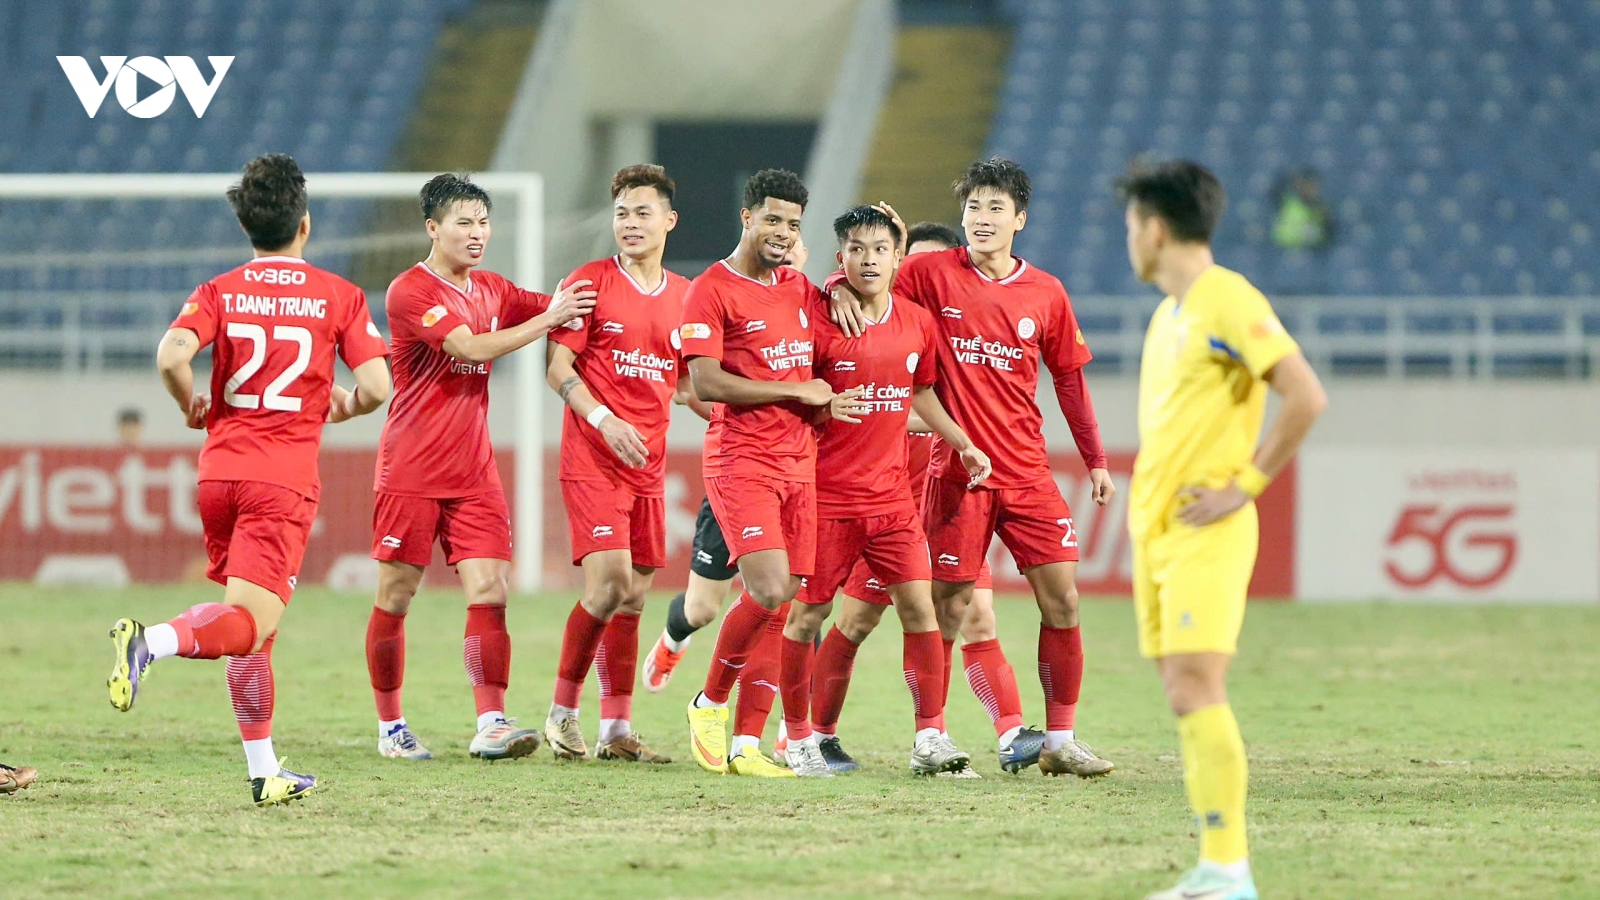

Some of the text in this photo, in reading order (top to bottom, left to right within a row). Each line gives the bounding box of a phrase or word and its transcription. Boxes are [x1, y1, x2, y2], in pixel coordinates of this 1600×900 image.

[243, 268, 306, 285] tv360
[222, 293, 327, 319] T. DANH TRUNG
[760, 338, 813, 359] THỂ CÔNG
[950, 335, 1023, 360] THỂ CÔNG
[223, 322, 312, 412] 22
[611, 347, 675, 371] THỂ CÔNG
[768, 354, 813, 371] VIETTEL
[955, 350, 1014, 371] VIETTEL
[614, 363, 666, 383] VIETTEL
[877, 384, 911, 399] CÔNG
[848, 400, 904, 412] ETTEL
[1383, 502, 1518, 588] 5G
